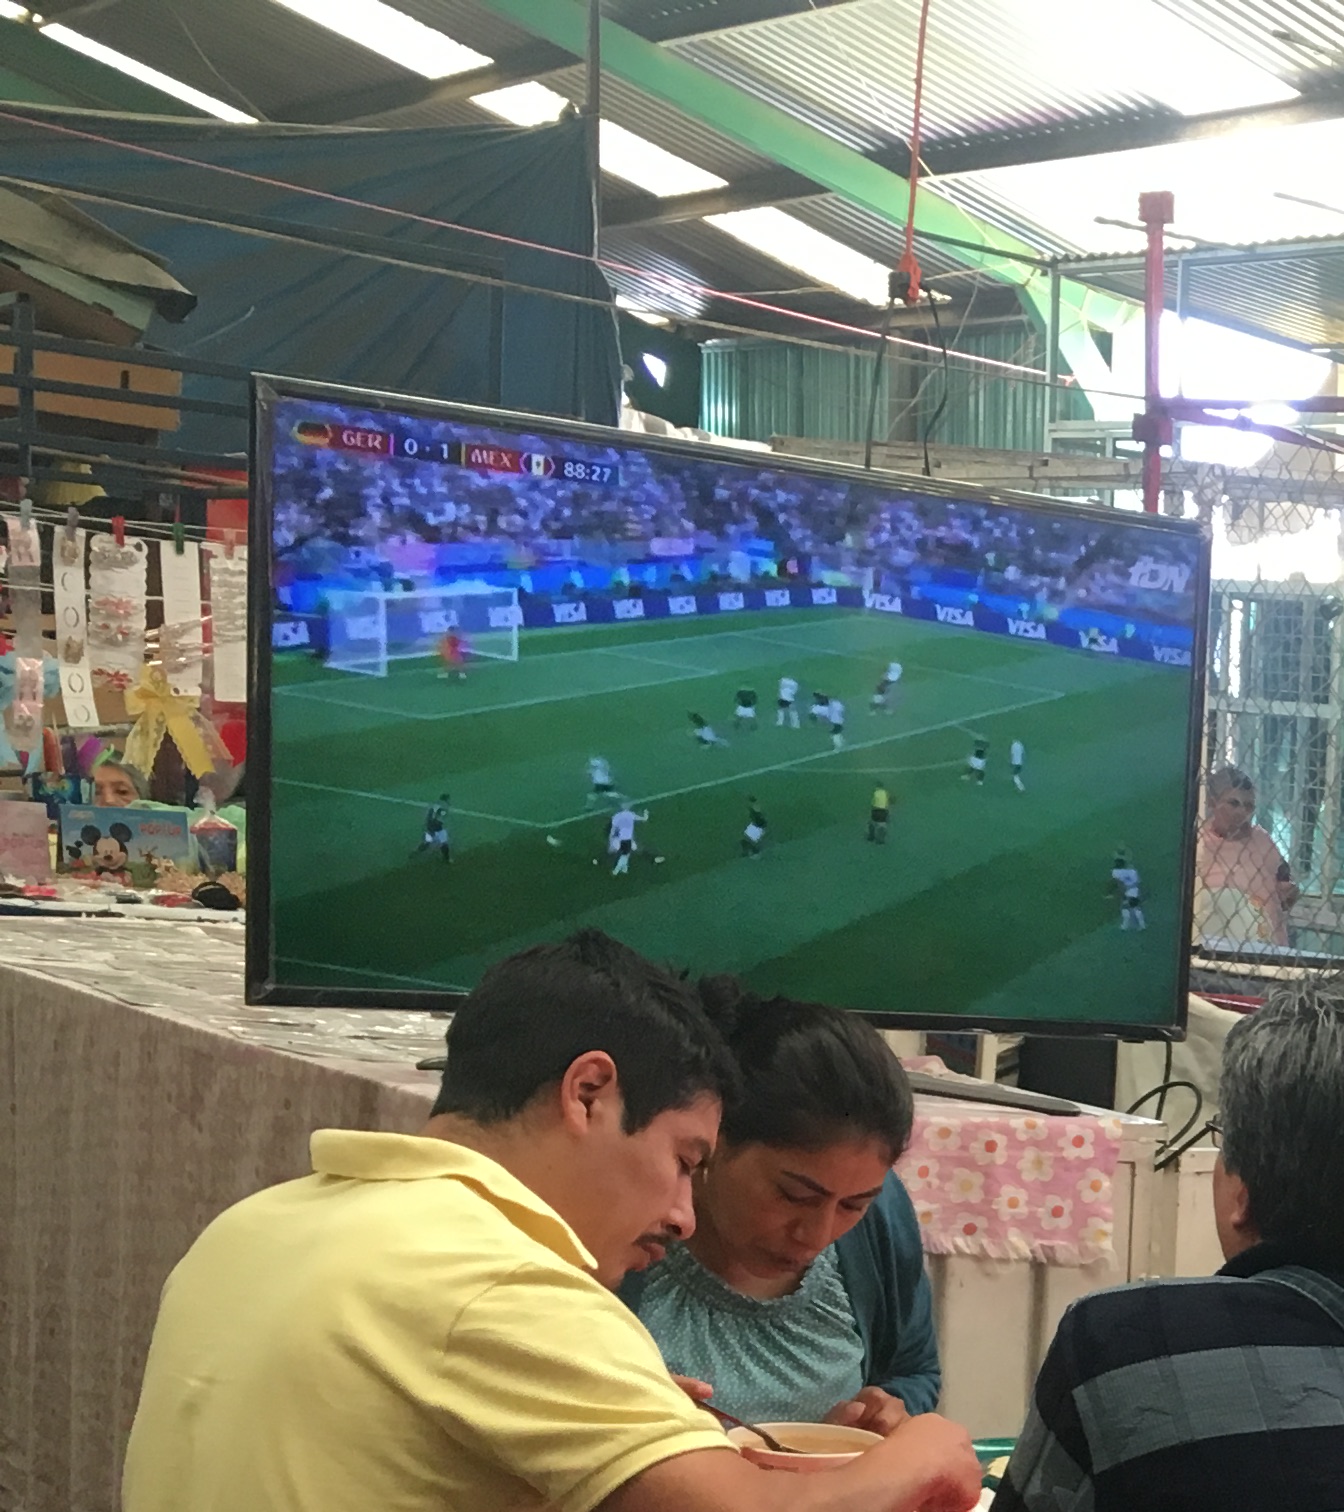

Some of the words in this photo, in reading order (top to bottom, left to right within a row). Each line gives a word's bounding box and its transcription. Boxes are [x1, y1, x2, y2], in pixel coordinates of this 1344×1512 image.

[342, 430, 382, 450] GER
[470, 449, 512, 469] MEX
[563, 461, 612, 483] 88:27
[935, 603, 974, 627] VISA
[1007, 617, 1046, 640] VISA
[1152, 642, 1191, 667] VISA
